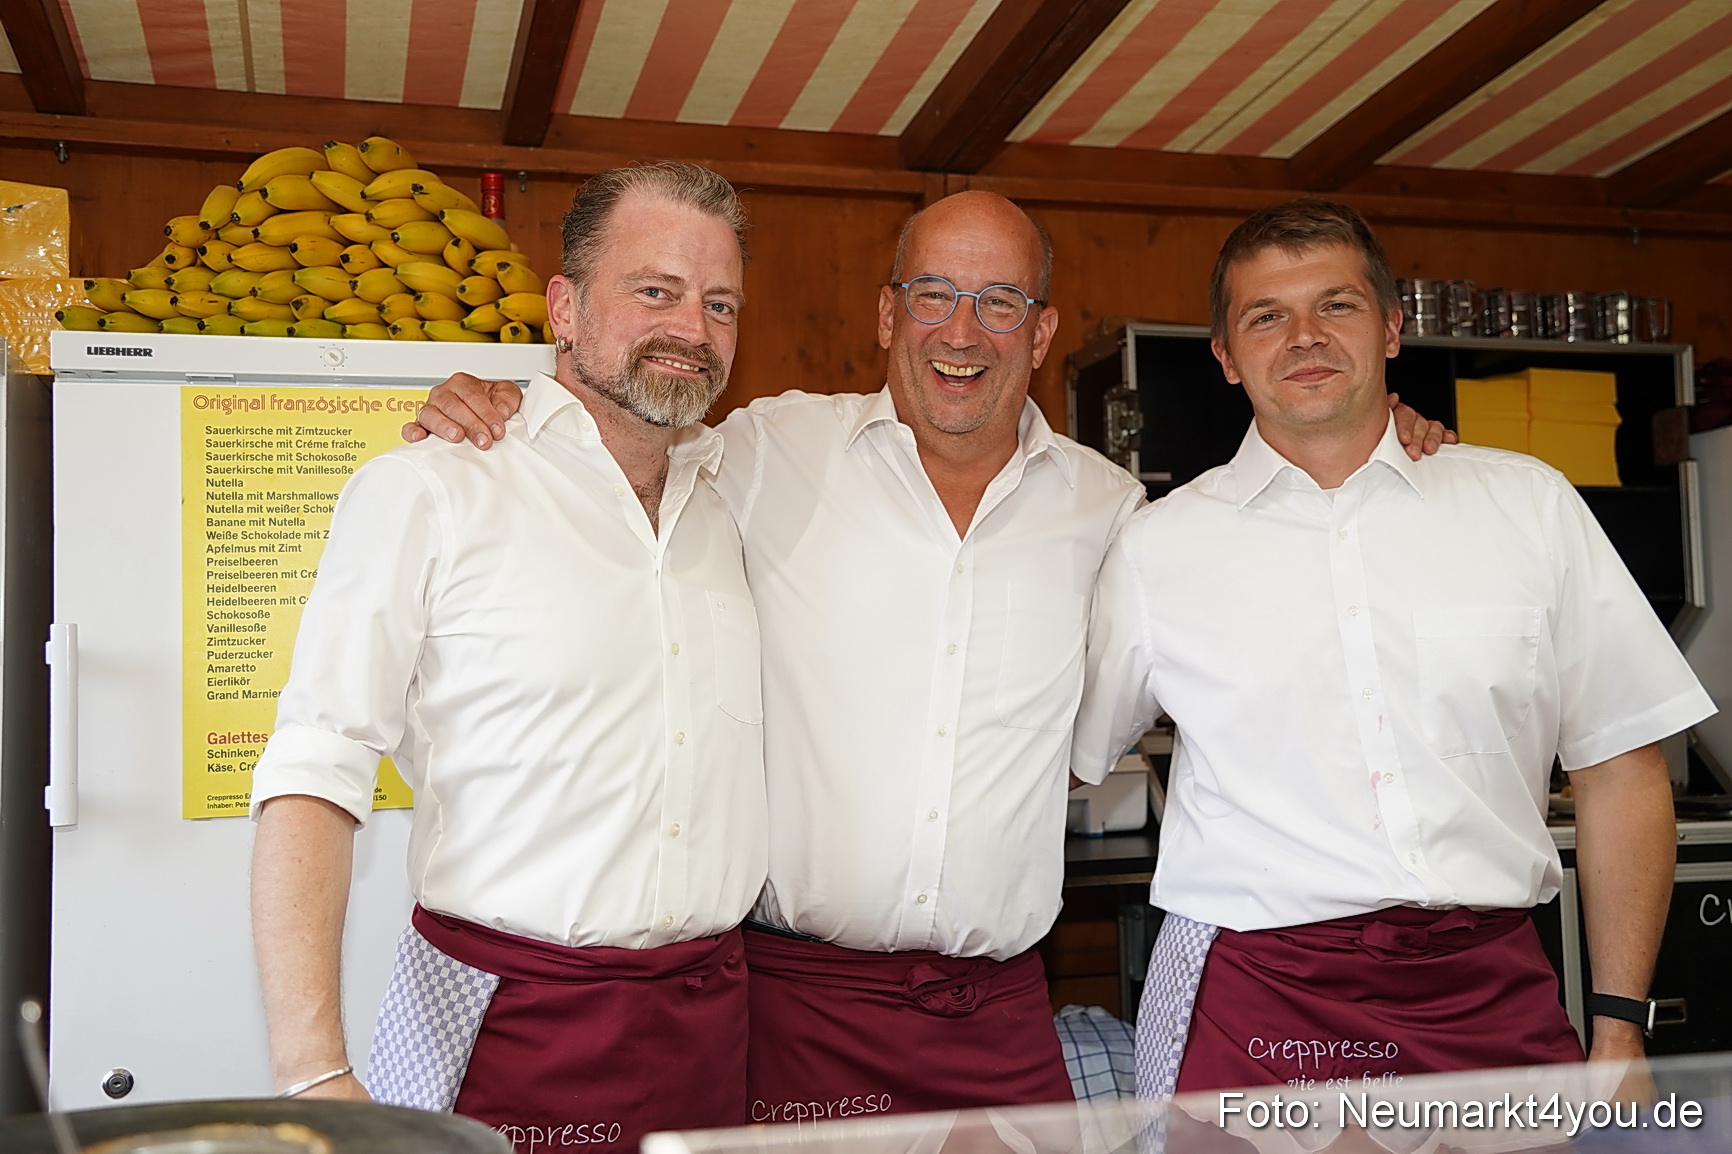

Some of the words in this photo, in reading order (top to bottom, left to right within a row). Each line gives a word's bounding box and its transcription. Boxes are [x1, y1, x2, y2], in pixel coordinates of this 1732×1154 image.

[86, 346, 153, 357] LIEBHERR
[193, 394, 265, 415] Original
[271, 394, 382, 414] französische
[205, 425, 274, 436] Sauerkirsche
[275, 425, 293, 436] mit
[295, 426, 353, 436] Zimtzucker
[205, 438, 274, 449] Sauerkirsche
[276, 438, 294, 449] mit
[295, 438, 329, 449] Créme
[205, 451, 274, 462] Sauerkirsche
[276, 451, 294, 462] mit
[295, 451, 358, 462] Schokosoße
[205, 464, 274, 475] Sauerkirsche
[276, 464, 294, 475] mit
[295, 464, 354, 475] Vanillesoße
[205, 477, 244, 488] Nutella
[206, 491, 244, 501] Nutella
[246, 490, 264, 501] mit
[266, 491, 340, 501] Marshmallows
[206, 504, 244, 514] Nutella
[246, 503, 264, 514] mit
[265, 503, 301, 514] weißer
[206, 517, 247, 527] Banane
[248, 517, 266, 527] mit
[268, 517, 306, 527] Nutella
[205, 530, 239, 541] Weiße
[240, 530, 302, 540] Schokolade
[303, 529, 321, 540] mit
[206, 544, 256, 555] Apfelmus
[258, 543, 276, 553] mit
[277, 543, 302, 553] Zimt
[206, 556, 279, 567] Preiselbeeren
[206, 569, 279, 580] Preiselbeeren
[280, 569, 299, 579] mit
[206, 583, 277, 594] Heidelbeeren
[206, 596, 277, 607] Heidelbeeren
[279, 595, 297, 606] mit
[298, 595, 308, 605] C
[206, 609, 271, 621] Schokosoße
[206, 622, 267, 634] Vanillesoße
[206, 636, 267, 647] Zimtzucker
[206, 649, 274, 661] Puderzucker
[206, 663, 257, 674] Amaretto
[207, 676, 251, 687] Eierlikör
[206, 689, 239, 701] Grand
[241, 688, 281, 700] Marnier
[208, 732, 268, 744] Galettes
[206, 748, 260, 760] Schinken,
[207, 762, 237, 774] Käse,
[1248, 1037, 1399, 1070] Creppresso
[1325, 1075, 1352, 1090] est
[1362, 1071, 1404, 1088] belle
[752, 1093, 892, 1130] Creppresso
[489, 1122, 621, 1154] eppresso
